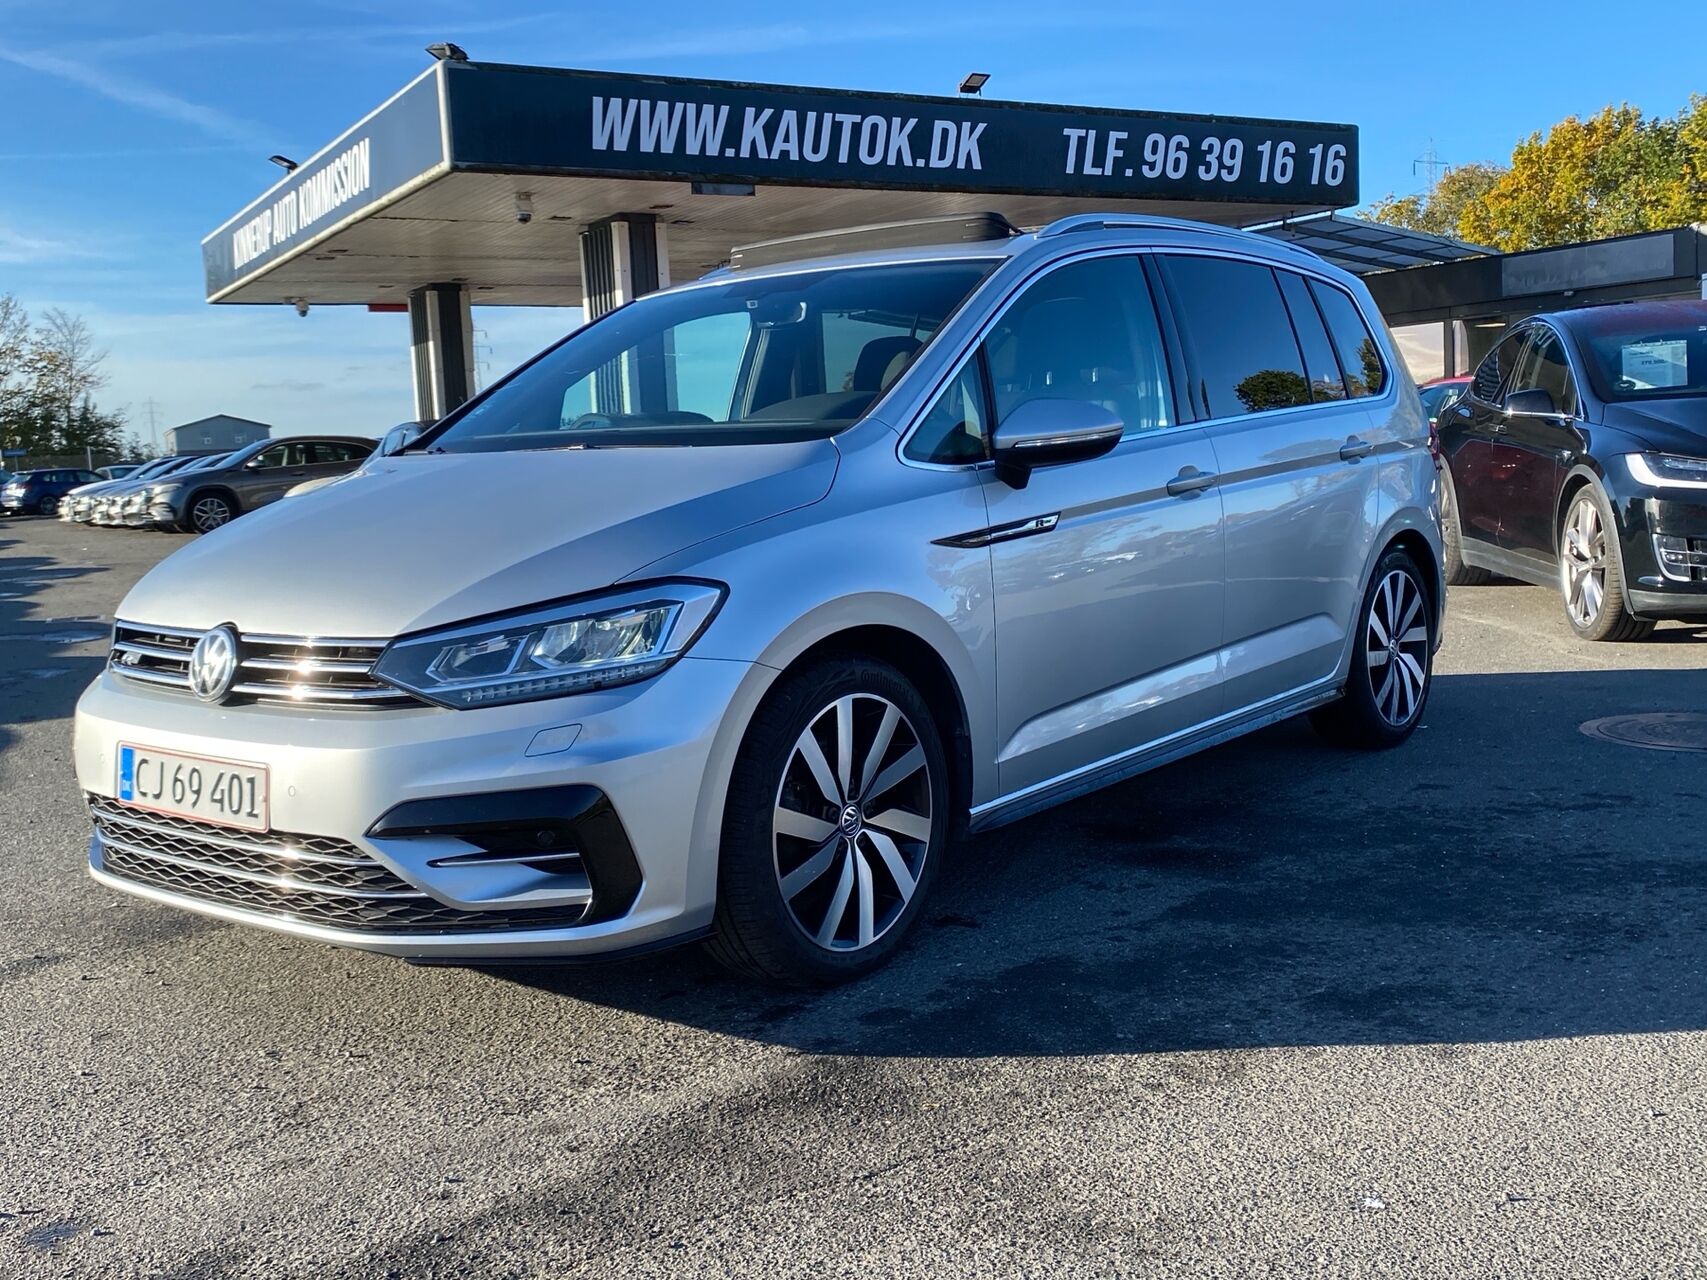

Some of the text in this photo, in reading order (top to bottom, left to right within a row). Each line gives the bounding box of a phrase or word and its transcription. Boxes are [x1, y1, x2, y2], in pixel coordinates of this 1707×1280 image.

[592, 96, 987, 170] WWW.KAUTOK.DK
[1062, 128, 1347, 187] TLF. 96 39 16 16
[272, 191, 297, 246] AUTO
[298, 137, 370, 230] KOMMISSION
[136, 758, 259, 819] CJ 69 401
